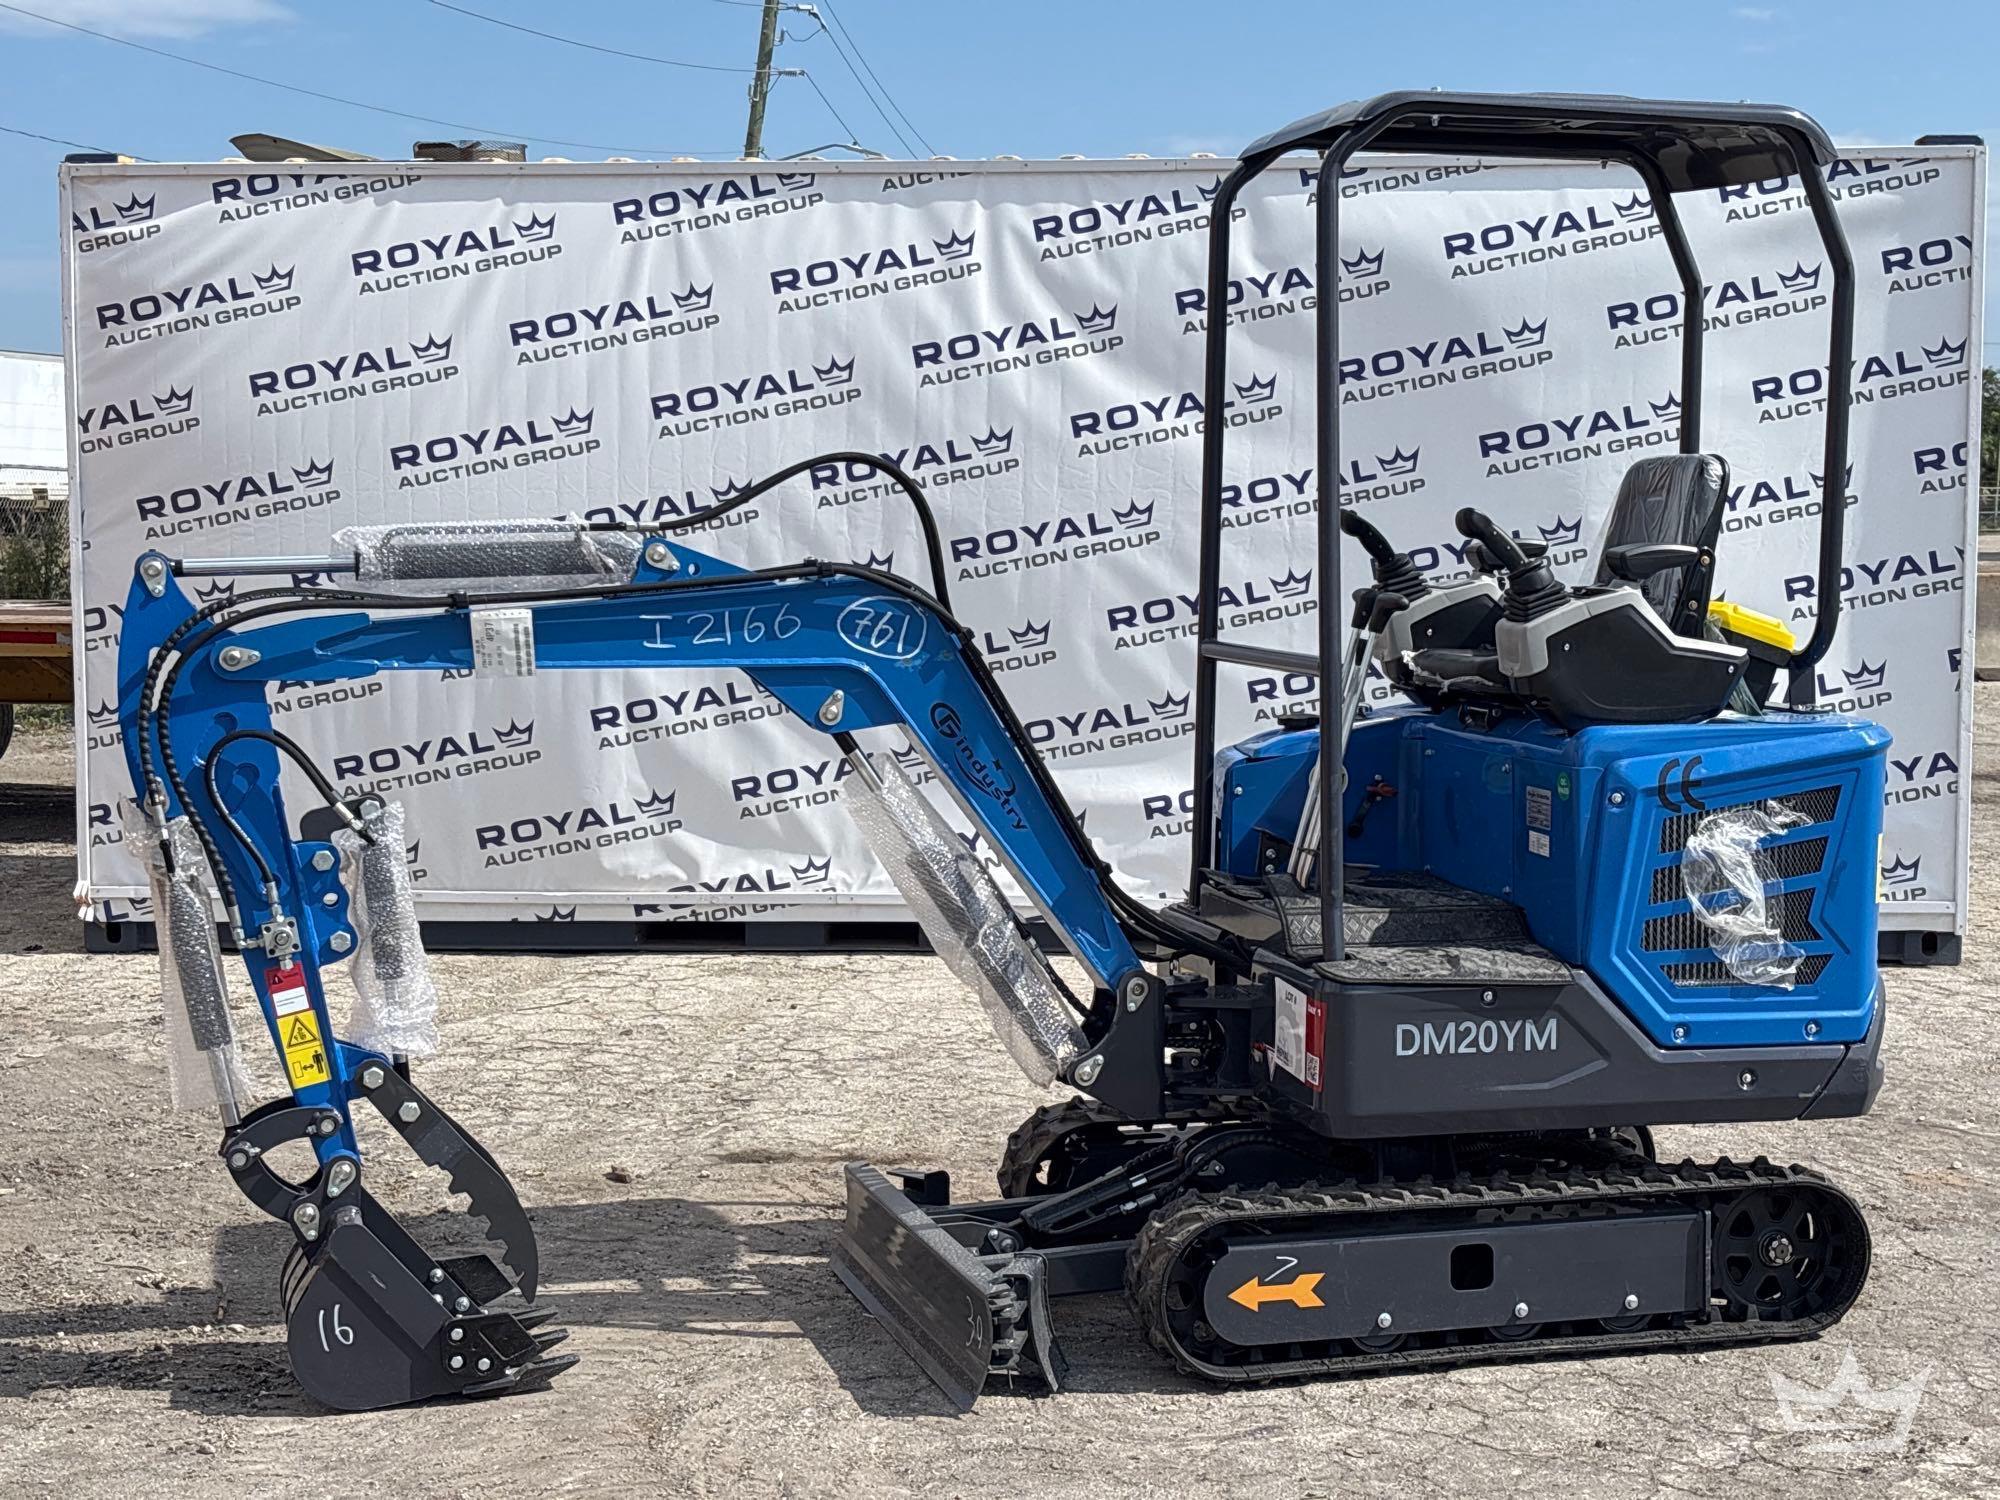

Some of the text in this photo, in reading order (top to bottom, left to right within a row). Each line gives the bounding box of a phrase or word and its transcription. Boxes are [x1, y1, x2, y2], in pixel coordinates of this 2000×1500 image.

[219, 190, 328, 224] AUCTION
[612, 174, 776, 226] ROYAL
[1306, 171, 1420, 207] ACTION
[1848, 168, 1940, 198] GROUP
[78, 224, 161, 253] GROUP
[620, 192, 823, 245] AUCTION GROUP
[1032, 189, 1198, 242] ROYAL
[1040, 207, 1246, 262] AUCTION GROP
[1443, 205, 1615, 260] ROYAL
[351, 225, 516, 276] ROYAL
[358, 244, 562, 296] AUCTION GROUP
[770, 243, 934, 294] ROYAL
[1450, 224, 1662, 279] AUCTION GROUP
[96, 277, 256, 328] ROYAL
[778, 262, 981, 314] AUCTION GROUP
[1301, 280, 1390, 313] GOUP
[1607, 276, 1779, 330] ROAL
[1888, 265, 1972, 294] AUCTI
[104, 295, 301, 348] AUCTION GROUP
[509, 295, 674, 346] ROYAL
[1735, 294, 1828, 325] GROUP
[516, 314, 720, 366] AUCTION GROUP
[912, 317, 1076, 368] ROYAL
[920, 336, 1123, 388] AUCTION GROUP
[1339, 332, 1505, 384] ROYAL
[248, 346, 412, 398] ROYAL
[256, 364, 459, 417] AUCTION GROUP
[651, 369, 816, 420] ROYAL
[1342, 349, 1553, 405] AUCTION GROUP
[1752, 350, 1923, 404] ROAL
[1758, 369, 1970, 424] AUCTN GROUP
[78, 398, 155, 435] YAL
[118, 417, 200, 446] GROUP
[658, 388, 862, 440] AUCTION GROUP
[1478, 404, 1650, 458] ROYAL
[390, 420, 554, 470] ROYAL
[398, 438, 601, 489] AUCTION GROUP
[1078, 425, 1188, 458] AUCTION
[1486, 426, 1681, 478] AUCTION GROU
[137, 470, 295, 520] ROYAL
[932, 458, 1020, 487] GROUP
[1220, 459, 1378, 509] ROYL
[1723, 476, 1810, 512] YAL
[144, 488, 339, 538] AUCTION GROUP
[1220, 478, 1426, 529] AUCTIO GROUP
[1769, 495, 1858, 525] GROP
[950, 512, 1114, 562] ROYAL
[958, 530, 1161, 581] AUCTION GROUP
[687, 602, 800, 645] 2166
[854, 607, 905, 653] 761
[1231, 600, 1318, 629] GROUP
[988, 650, 1057, 673] ROUP
[296, 682, 383, 711] GROUP
[589, 681, 754, 731] ROYAL
[596, 718, 708, 750] AUCTION
[1023, 704, 1150, 745] OYAL
[1110, 722, 1196, 749] GROUP
[334, 731, 495, 780] ROYAL
[341, 749, 541, 799] AUCTION GROUP
[475, 802, 636, 851] ROYAL
[482, 820, 682, 870] AUCTION GROUP
[1396, 1019, 1557, 1056] DM20YM
[318, 1304, 353, 1352] 16
